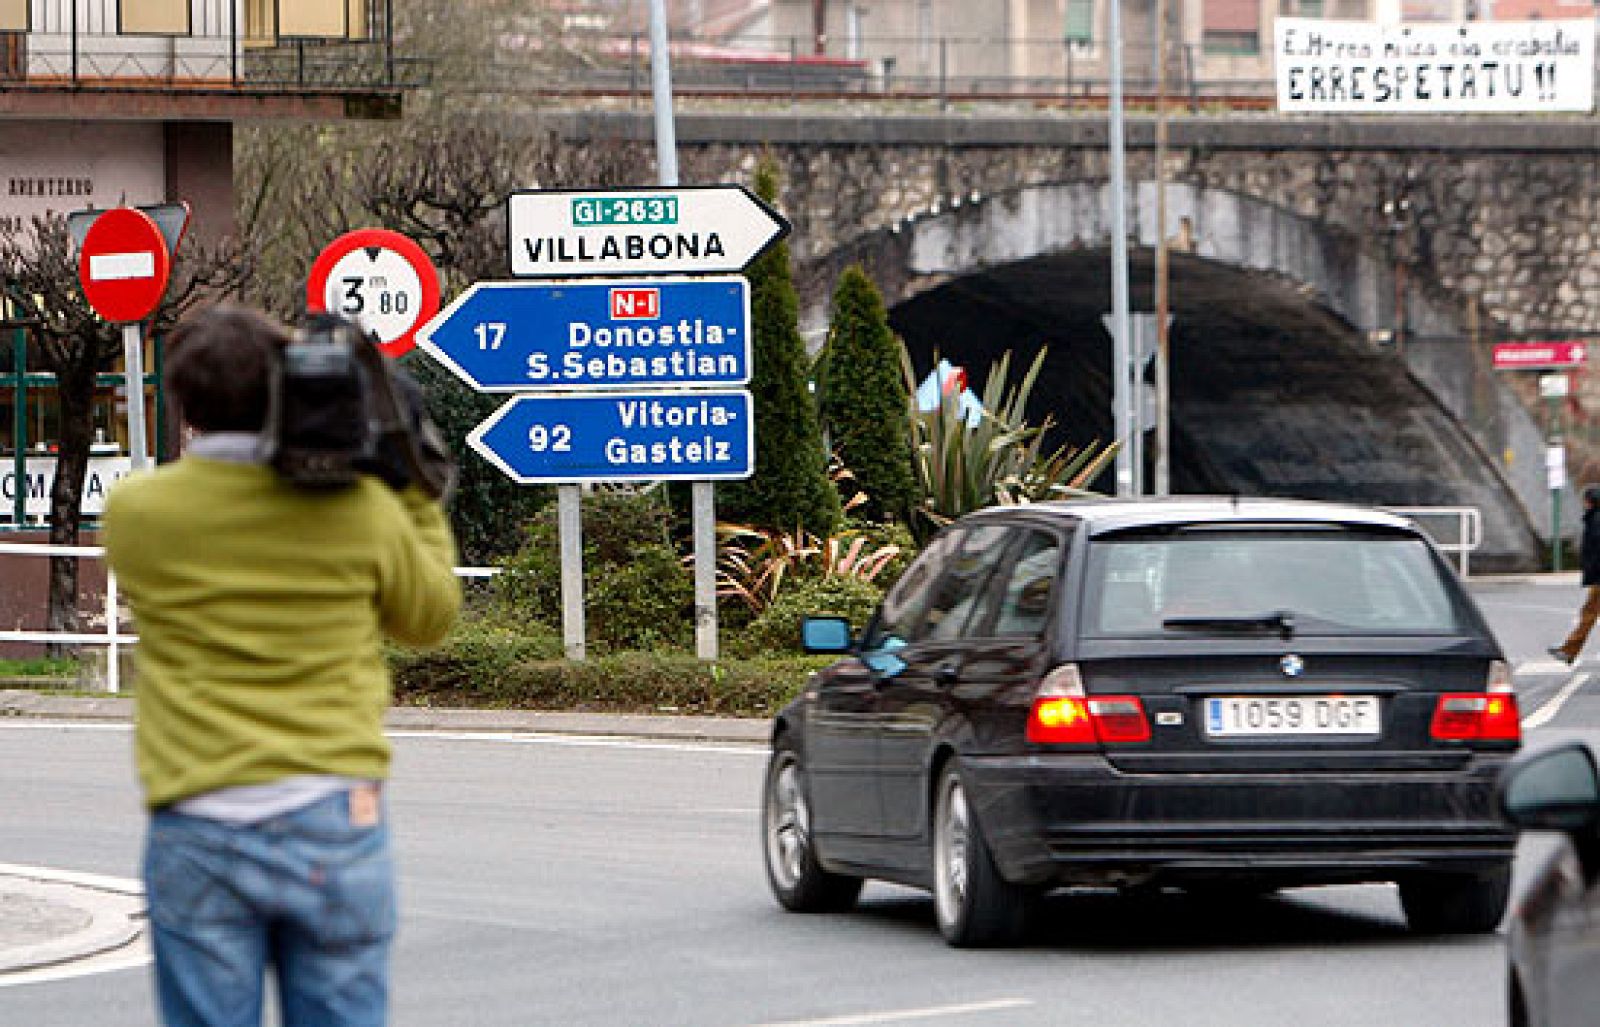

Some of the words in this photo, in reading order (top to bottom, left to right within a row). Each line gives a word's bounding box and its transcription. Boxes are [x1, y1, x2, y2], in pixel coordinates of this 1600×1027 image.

[575, 200, 677, 222] GI-2631
[524, 233, 725, 262] VILLABONA
[473, 322, 507, 350] 17
[568, 319, 737, 347] Donostia-
[526, 349, 737, 379] S.Sebastian
[617, 401, 737, 428] Vitoria-
[528, 424, 572, 452] 92
[605, 436, 731, 464] Gasteiz
[1231, 700, 1303, 728] 1059
